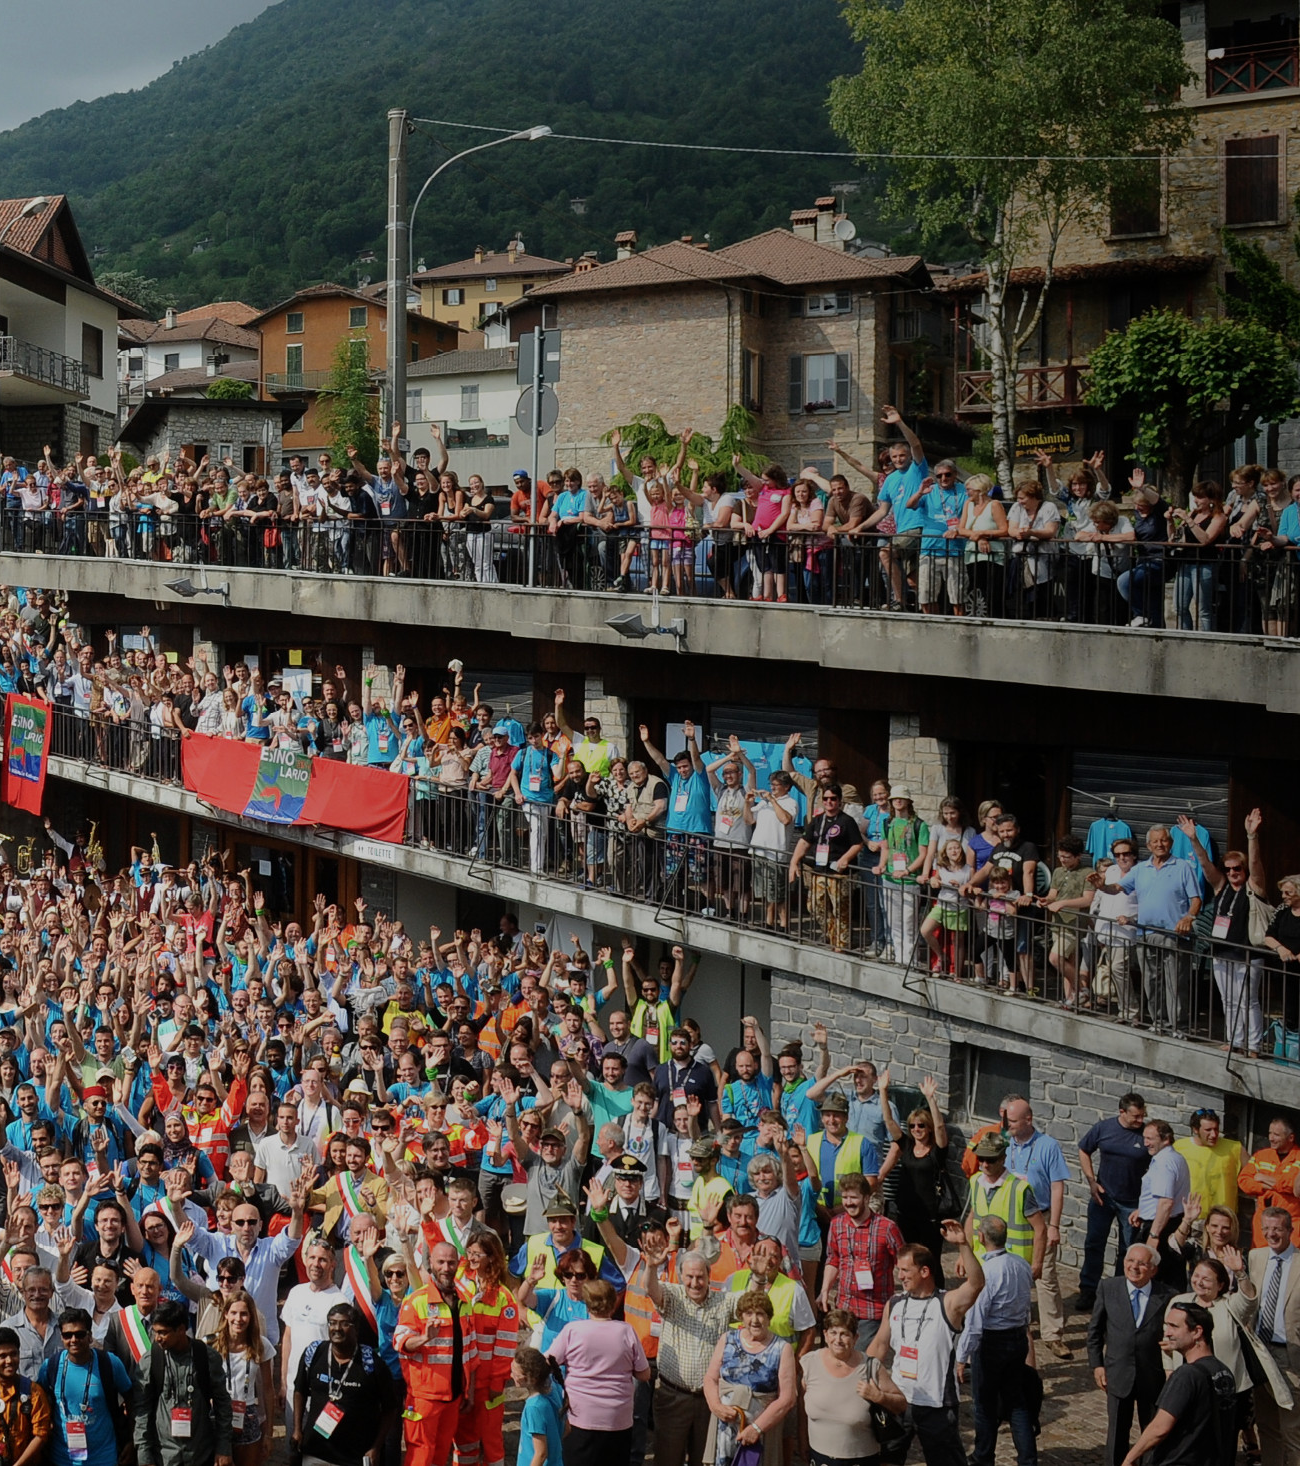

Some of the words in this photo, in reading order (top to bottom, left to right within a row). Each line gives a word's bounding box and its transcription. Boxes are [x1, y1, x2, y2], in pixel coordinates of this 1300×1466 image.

[1016, 432, 1070, 447] Montanina
[280, 766, 308, 782] LARIO
[368, 846, 392, 859] TOILETTE
